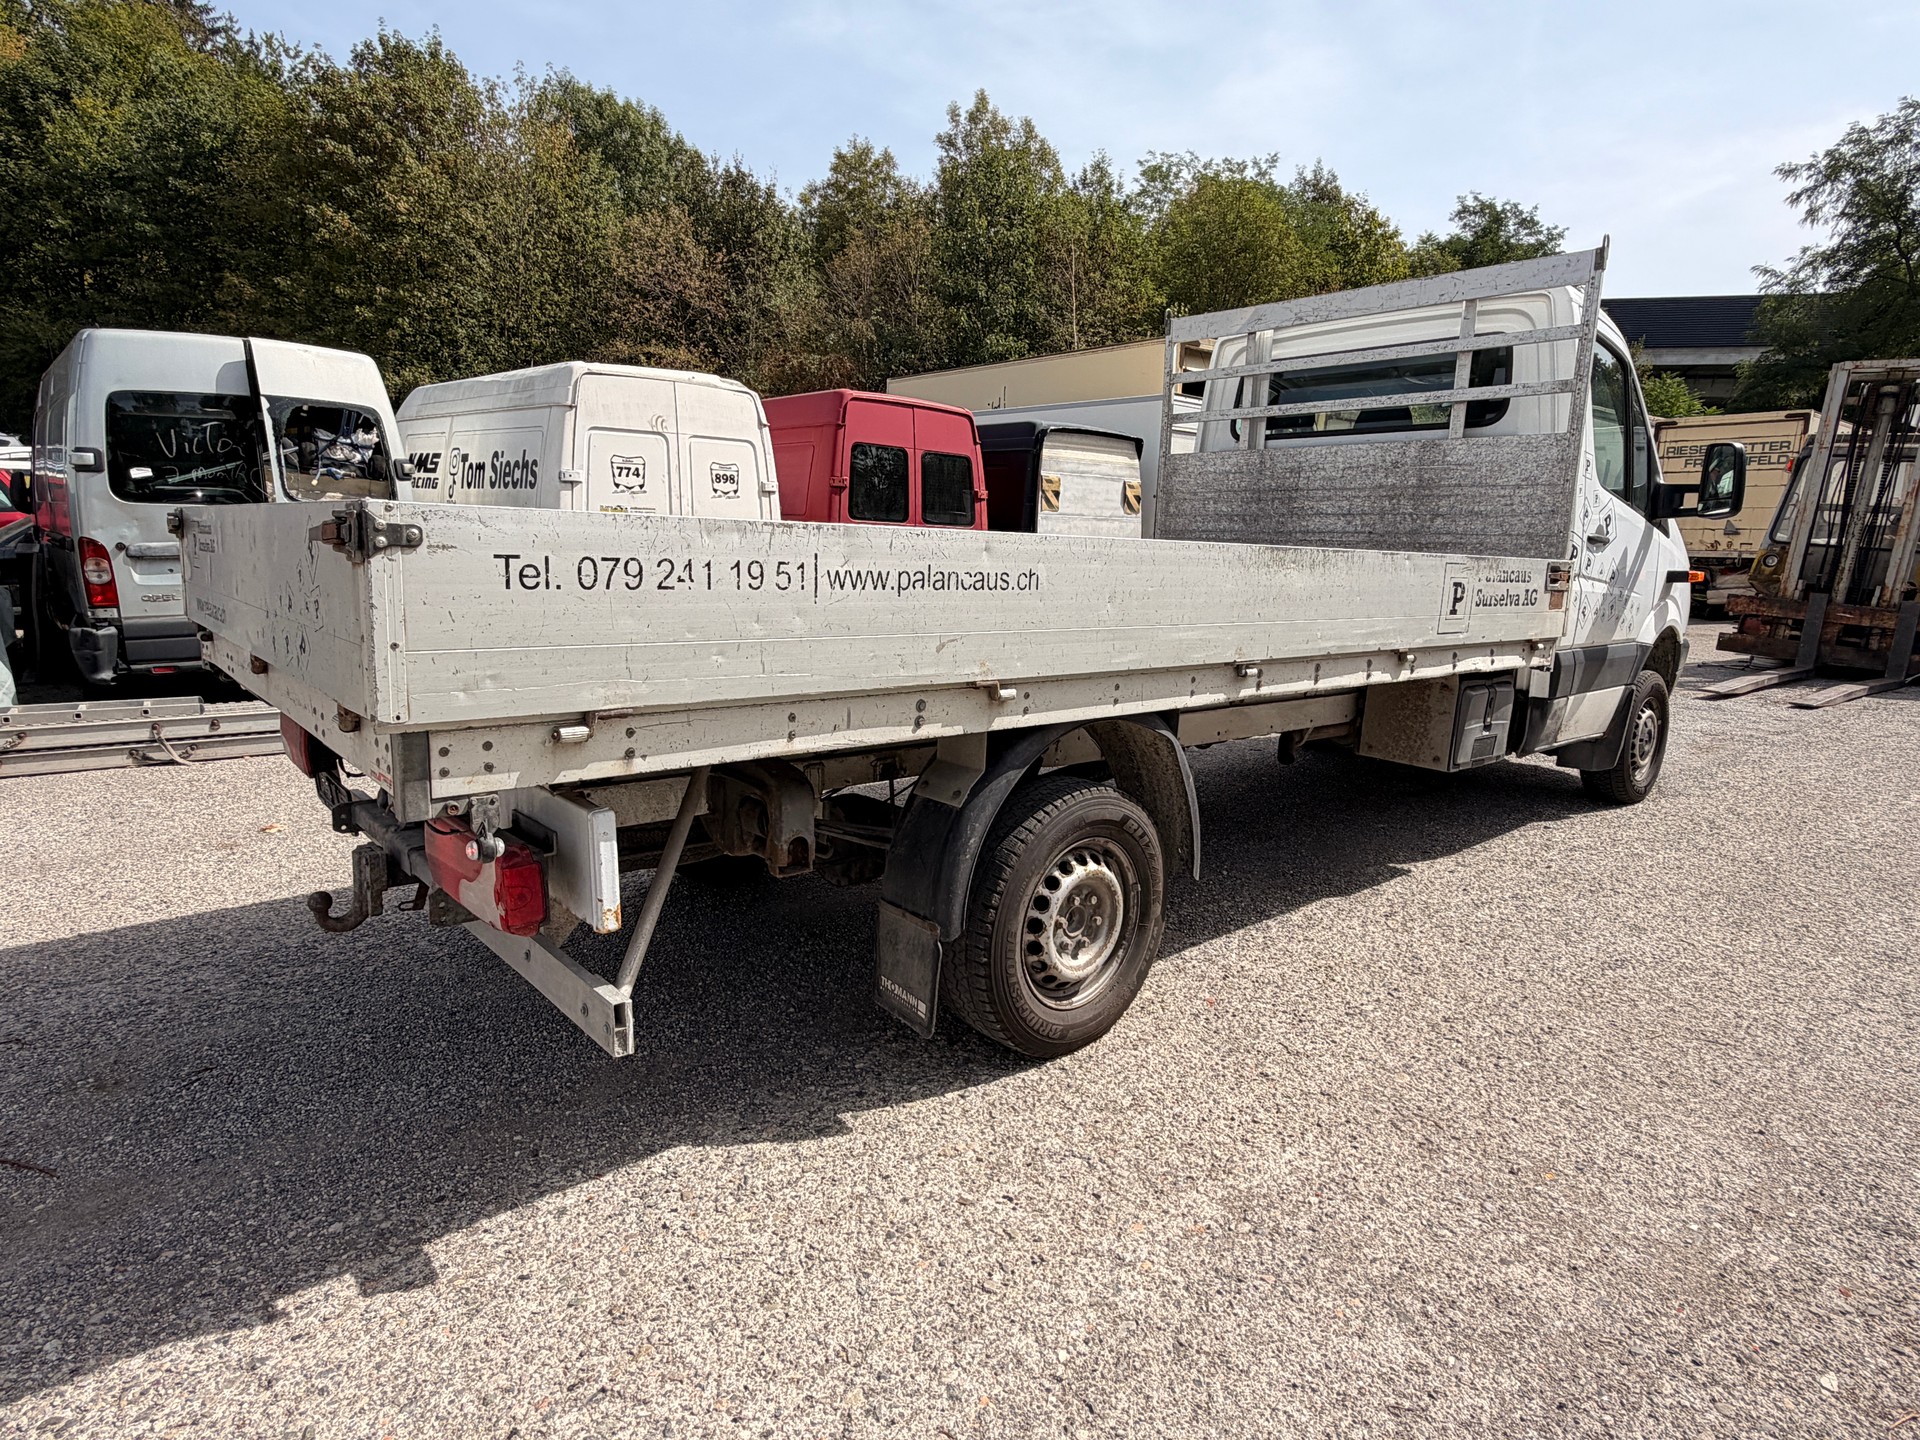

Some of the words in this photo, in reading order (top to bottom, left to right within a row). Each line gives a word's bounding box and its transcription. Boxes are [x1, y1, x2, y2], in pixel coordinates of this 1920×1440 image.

[460, 452, 486, 489] Tom
[489, 449, 539, 490] Siechs
[616, 465, 641, 478] 774
[715, 473, 736, 485] 898
[493, 554, 562, 590] Tel.
[577, 556, 644, 591] 079
[656, 558, 713, 591] 241
[730, 559, 765, 591] 19
[775, 561, 805, 591] 51
[826, 563, 1040, 598] www.palancaus.ch
[1449, 581, 1466, 615] P
[1475, 588, 1520, 608] Surselva
[1521, 588, 1539, 607] AG
